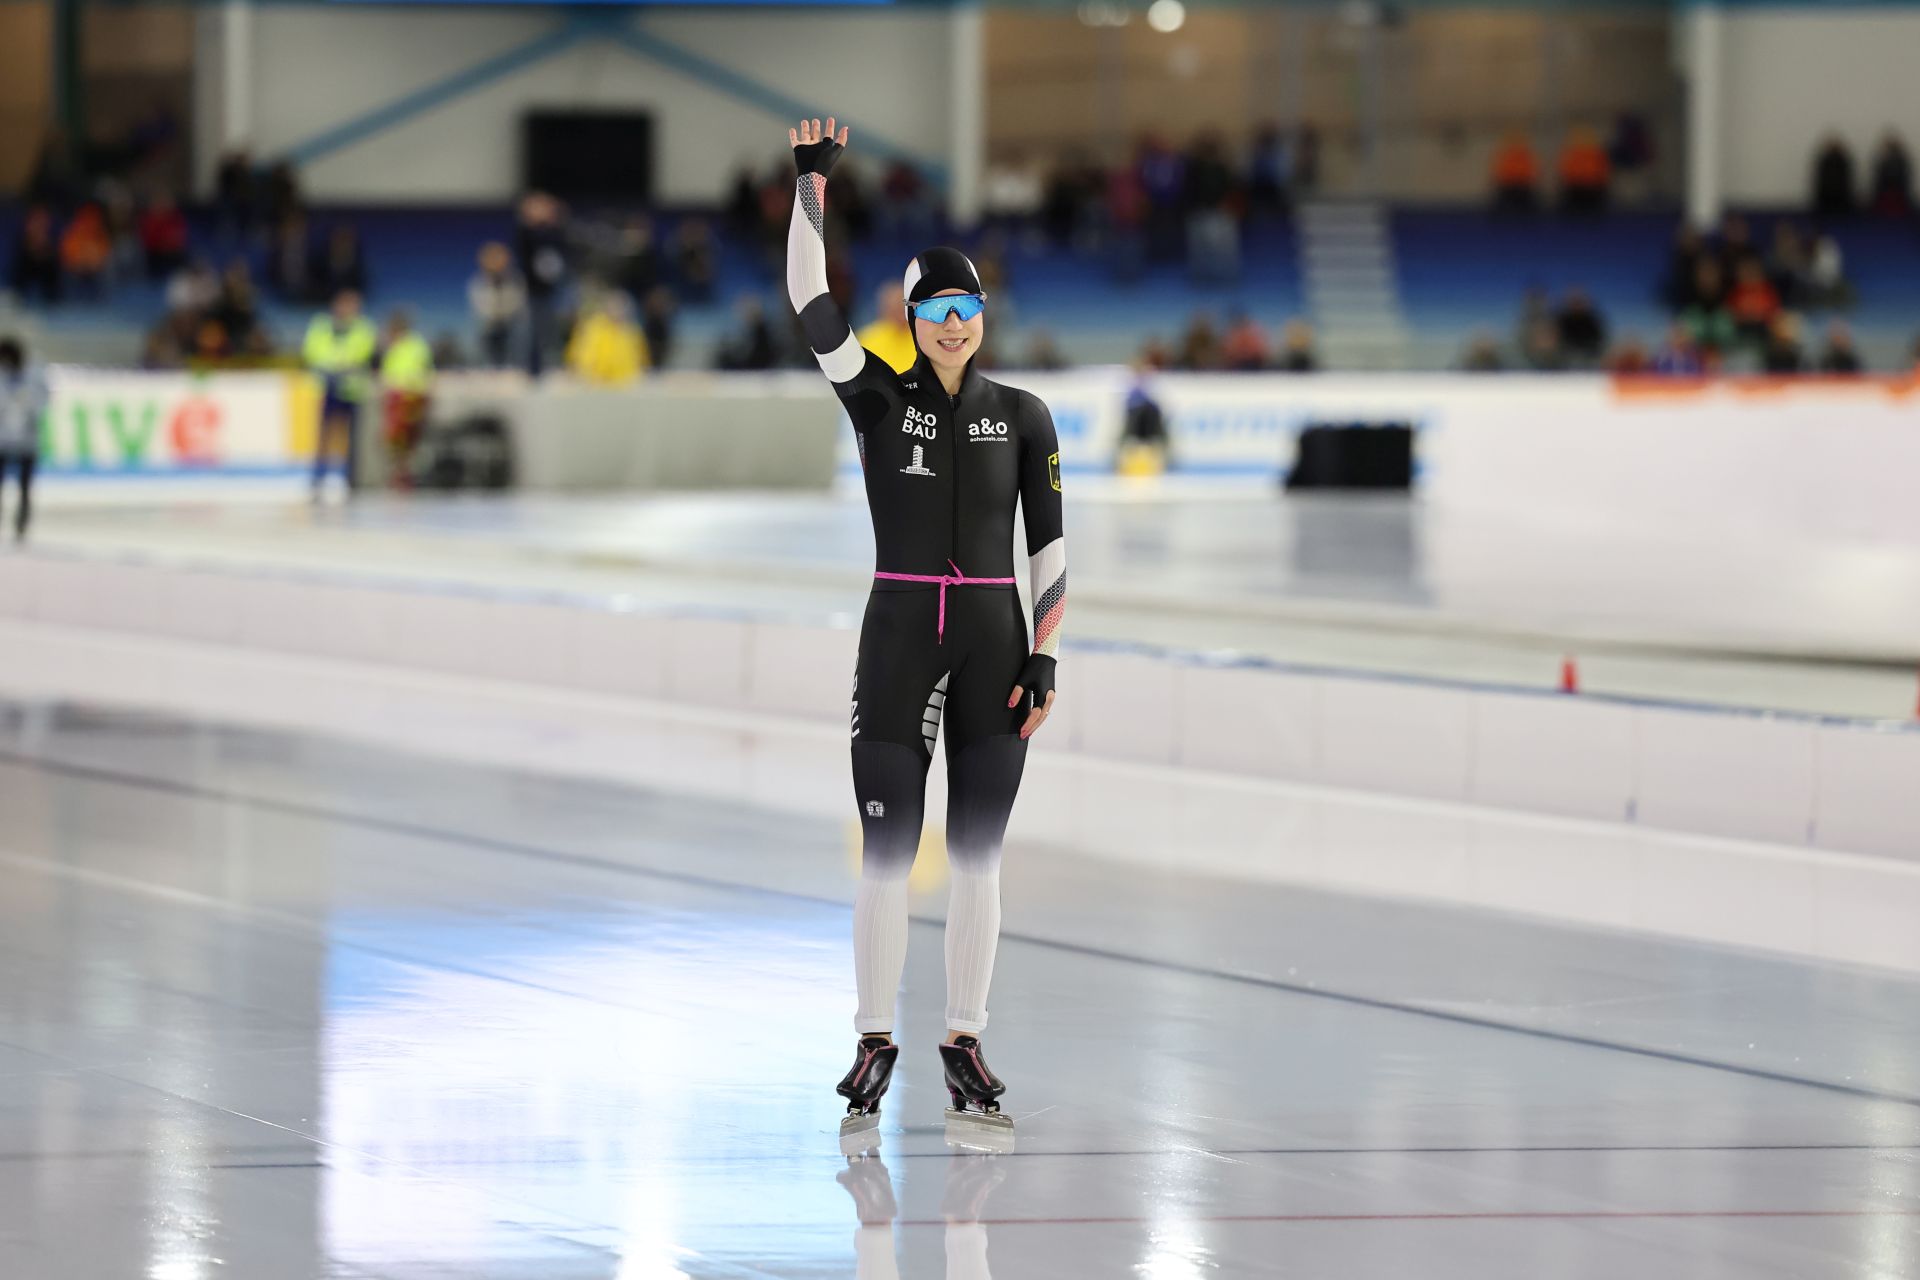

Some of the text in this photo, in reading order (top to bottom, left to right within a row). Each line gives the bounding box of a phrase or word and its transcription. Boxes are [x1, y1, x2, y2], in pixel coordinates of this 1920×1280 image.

[905, 405, 937, 427] B&O
[968, 417, 1008, 436] a&o
[901, 418, 937, 440] BAU
